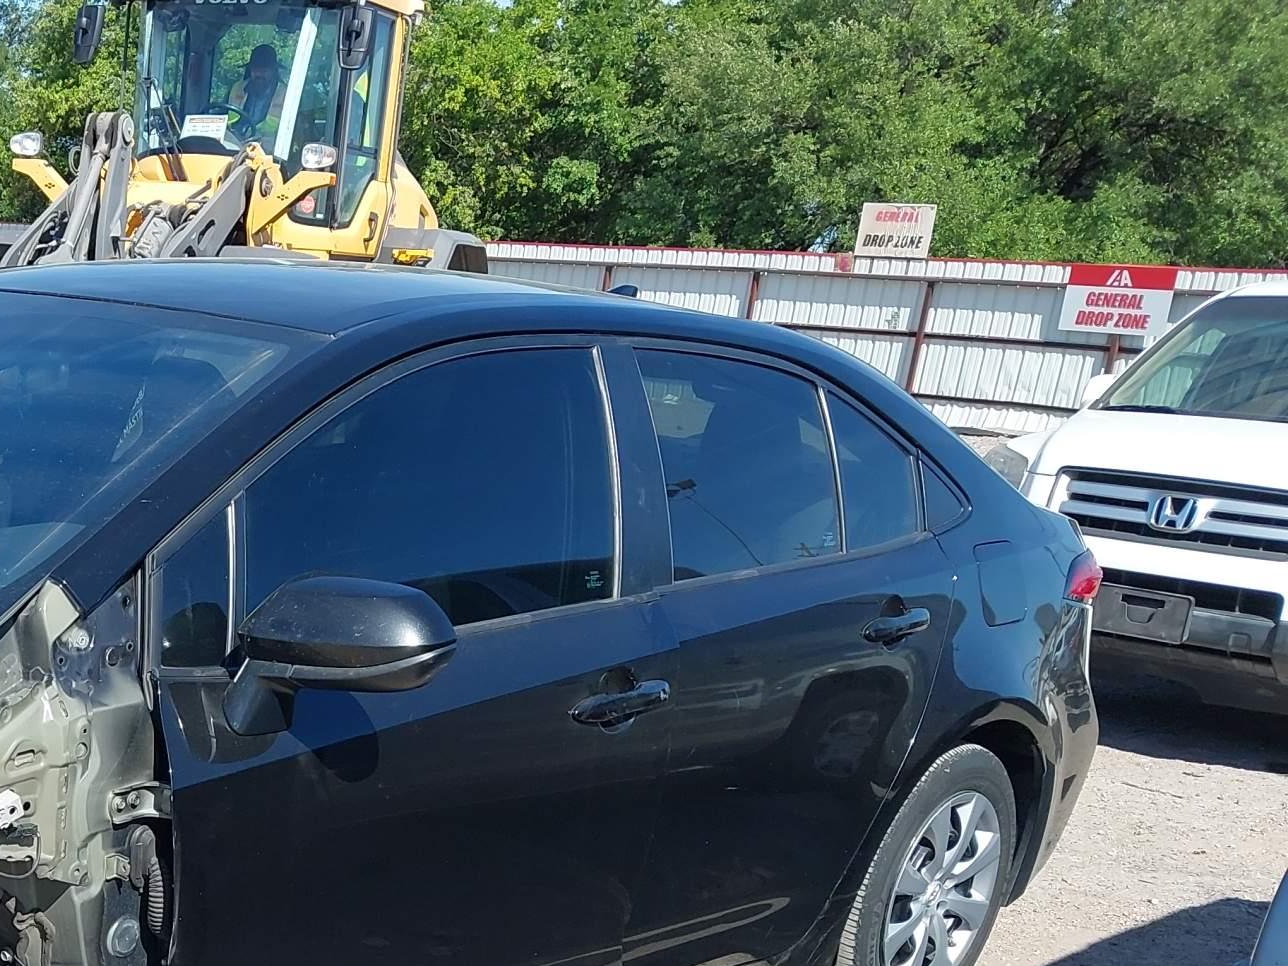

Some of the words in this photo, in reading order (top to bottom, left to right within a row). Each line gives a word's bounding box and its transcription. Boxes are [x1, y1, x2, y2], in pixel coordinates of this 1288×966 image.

[875, 210, 920, 223] GENERAL
[862, 234, 894, 248] DROP
[893, 235, 924, 249] ZONE
[1085, 291, 1144, 310] GENERAL
[1074, 310, 1114, 328] DROP
[1113, 312, 1151, 330] ZONE
